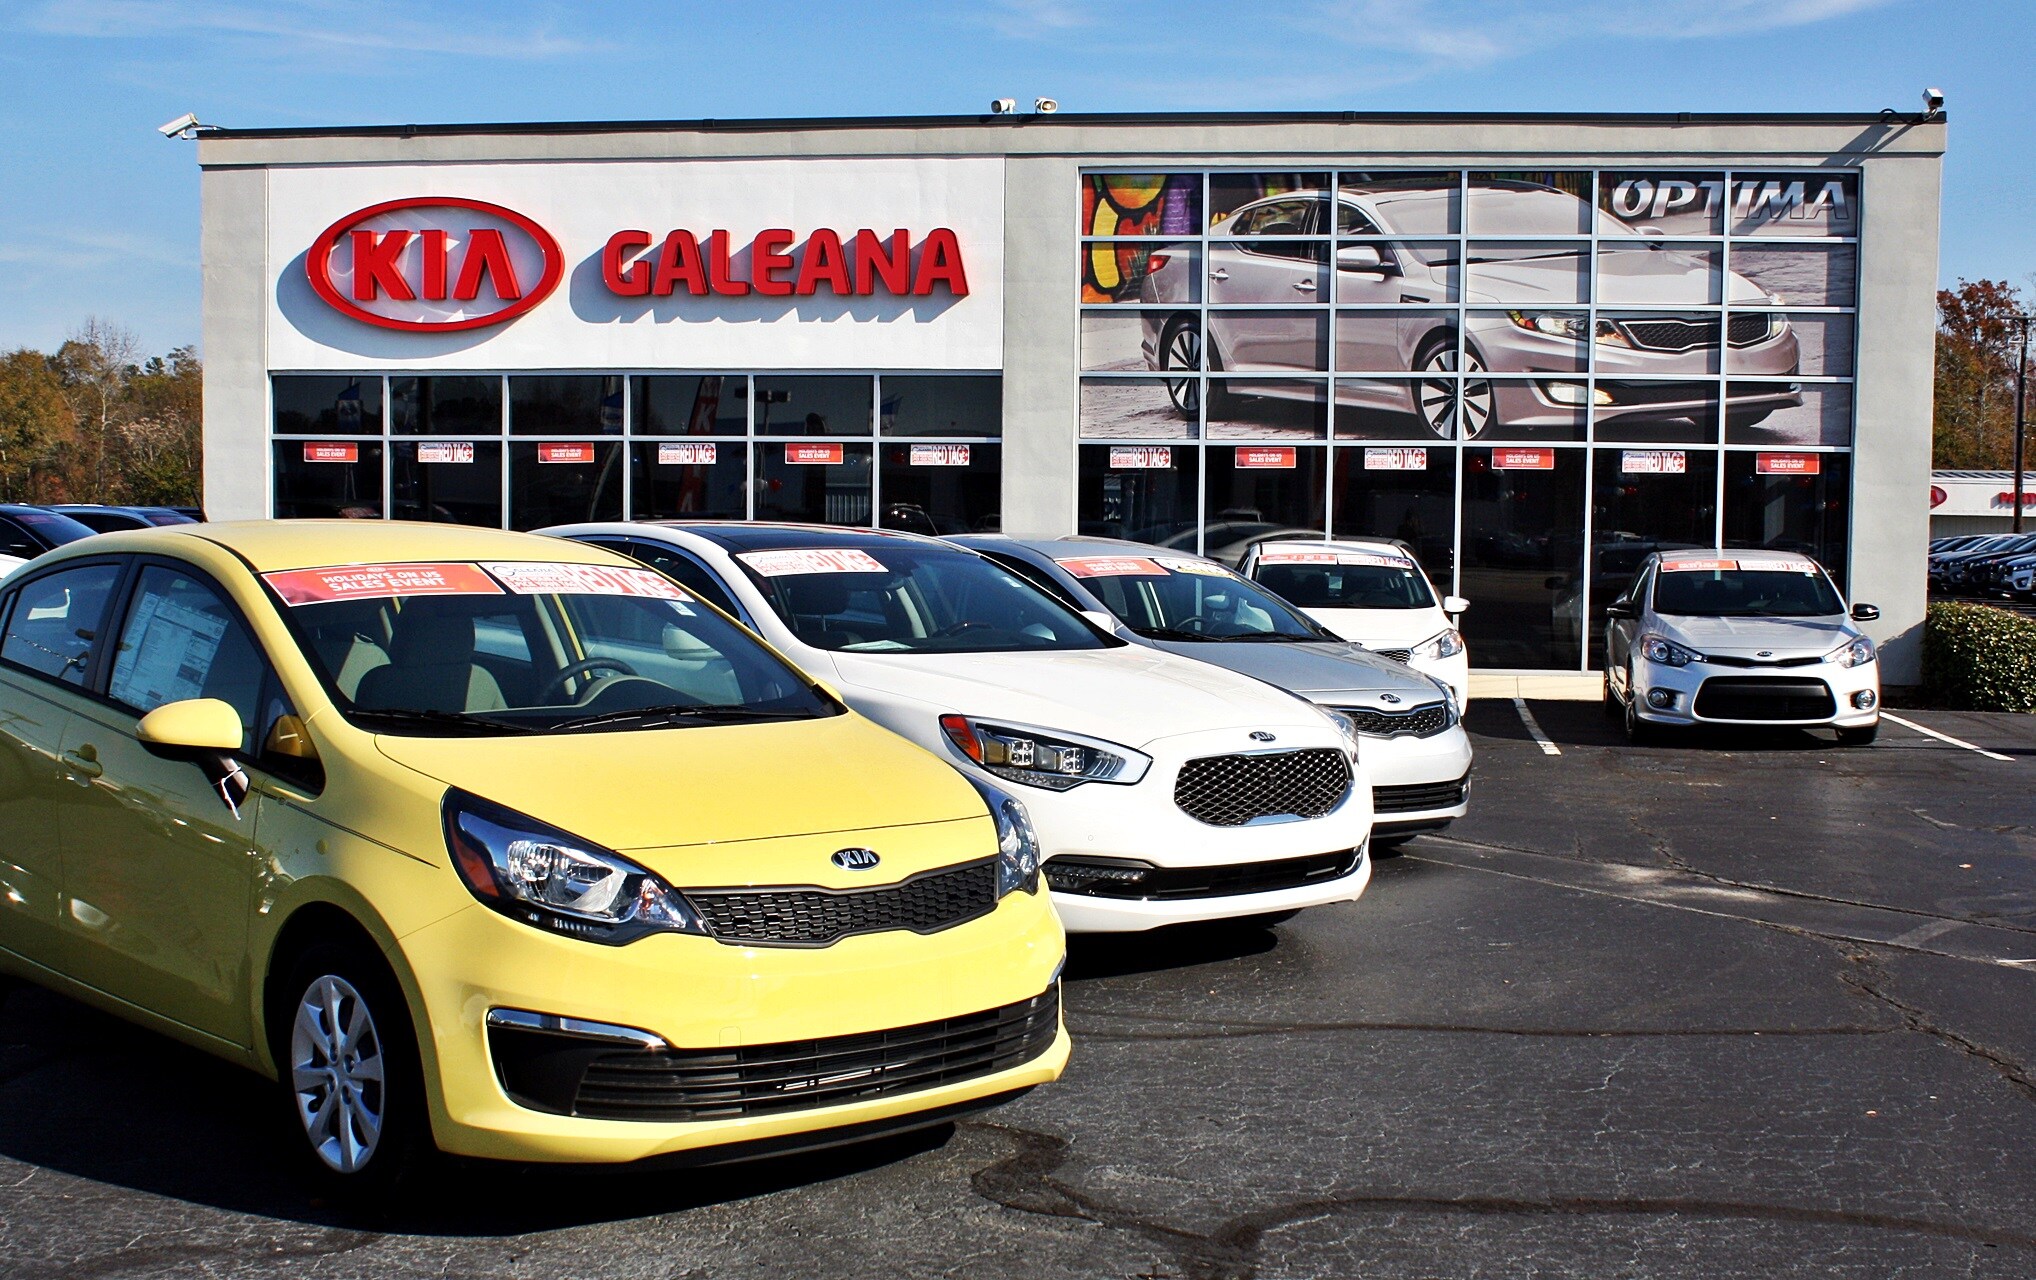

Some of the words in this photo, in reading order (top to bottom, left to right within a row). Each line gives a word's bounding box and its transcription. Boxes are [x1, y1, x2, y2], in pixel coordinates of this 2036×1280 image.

[1612, 179, 1849, 219] OPTIMA
[349, 228, 522, 300] KIA
[602, 228, 970, 297] GALEANA
[322, 572, 394, 584] HOLIDAYS
[328, 580, 386, 592] SALES
[387, 578, 446, 587] EVENT
[838, 850, 877, 866] KIA
